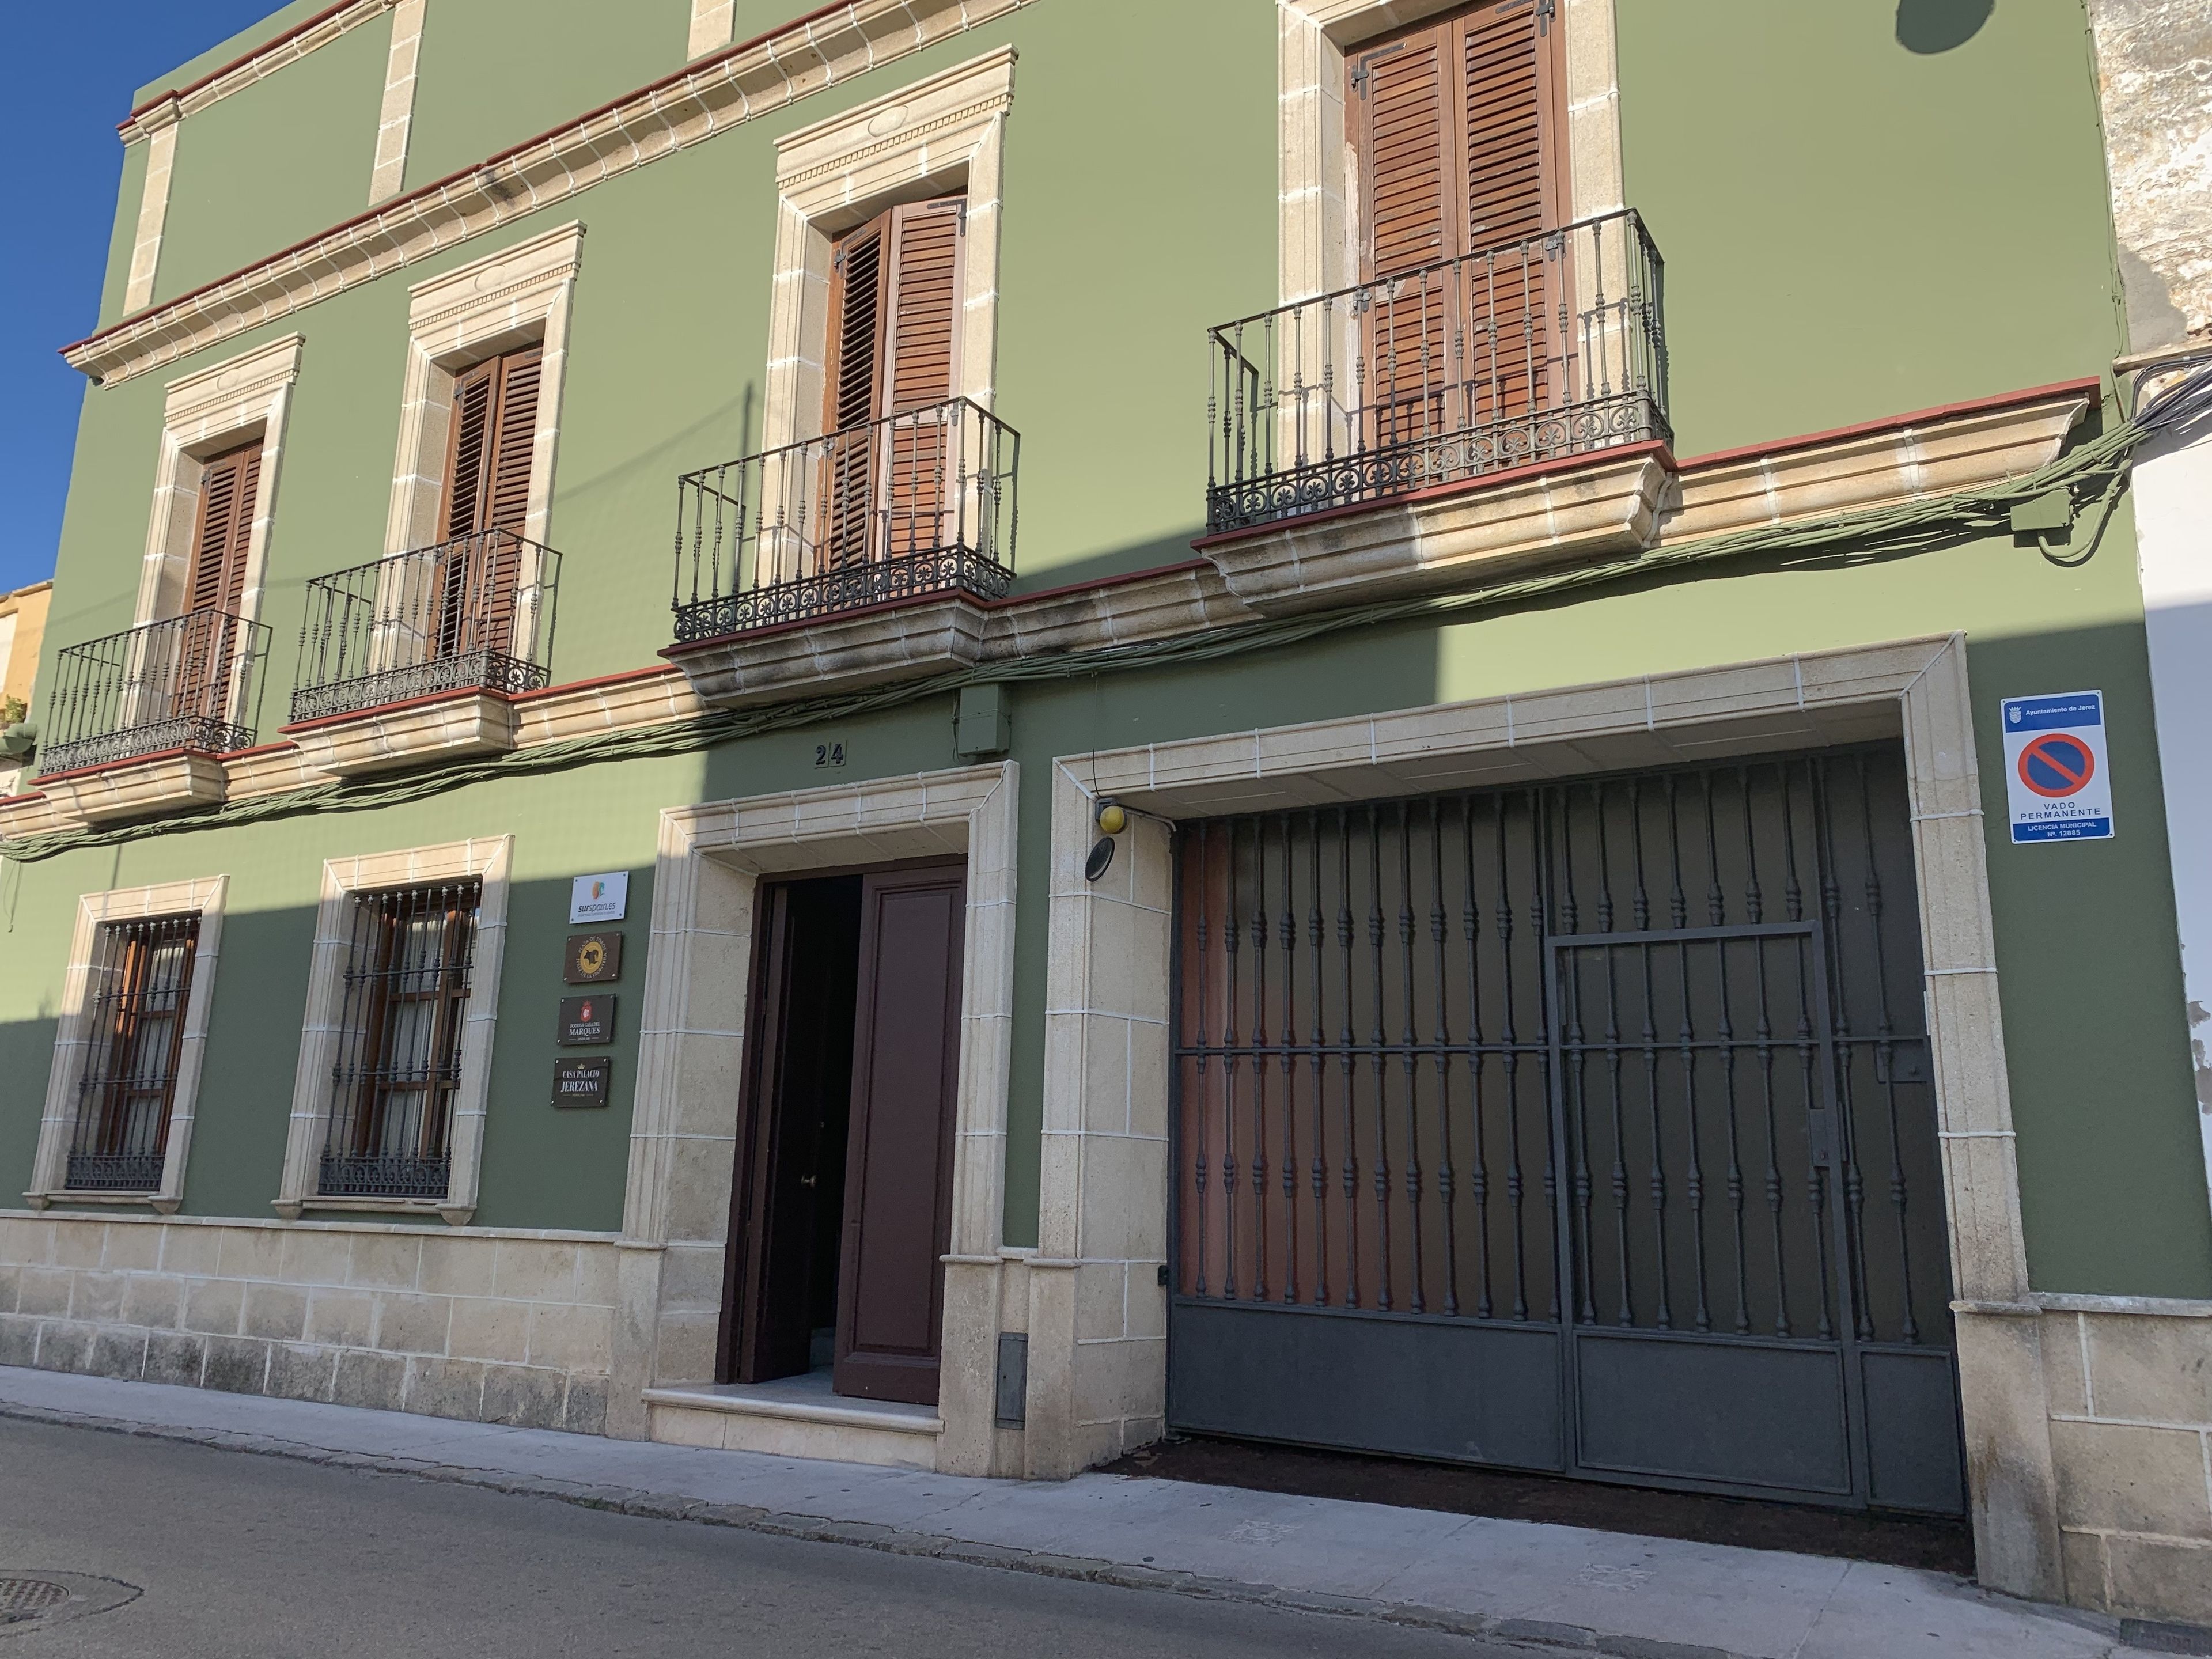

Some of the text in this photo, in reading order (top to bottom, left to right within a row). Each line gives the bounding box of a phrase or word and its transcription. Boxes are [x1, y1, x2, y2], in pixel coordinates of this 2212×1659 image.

[2026, 707, 2067, 716] Ayuntamiento
[816, 744, 844, 765] 24
[2044, 802, 2075, 810] VADO
[2021, 808, 2101, 820] PERMANENTE
[578, 902, 616, 912] surspain.es
[569, 1027, 600, 1036] MARQUES
[562, 1070, 600, 1078] CASA PALACIO
[560, 1080, 598, 1093] JEREZANA
